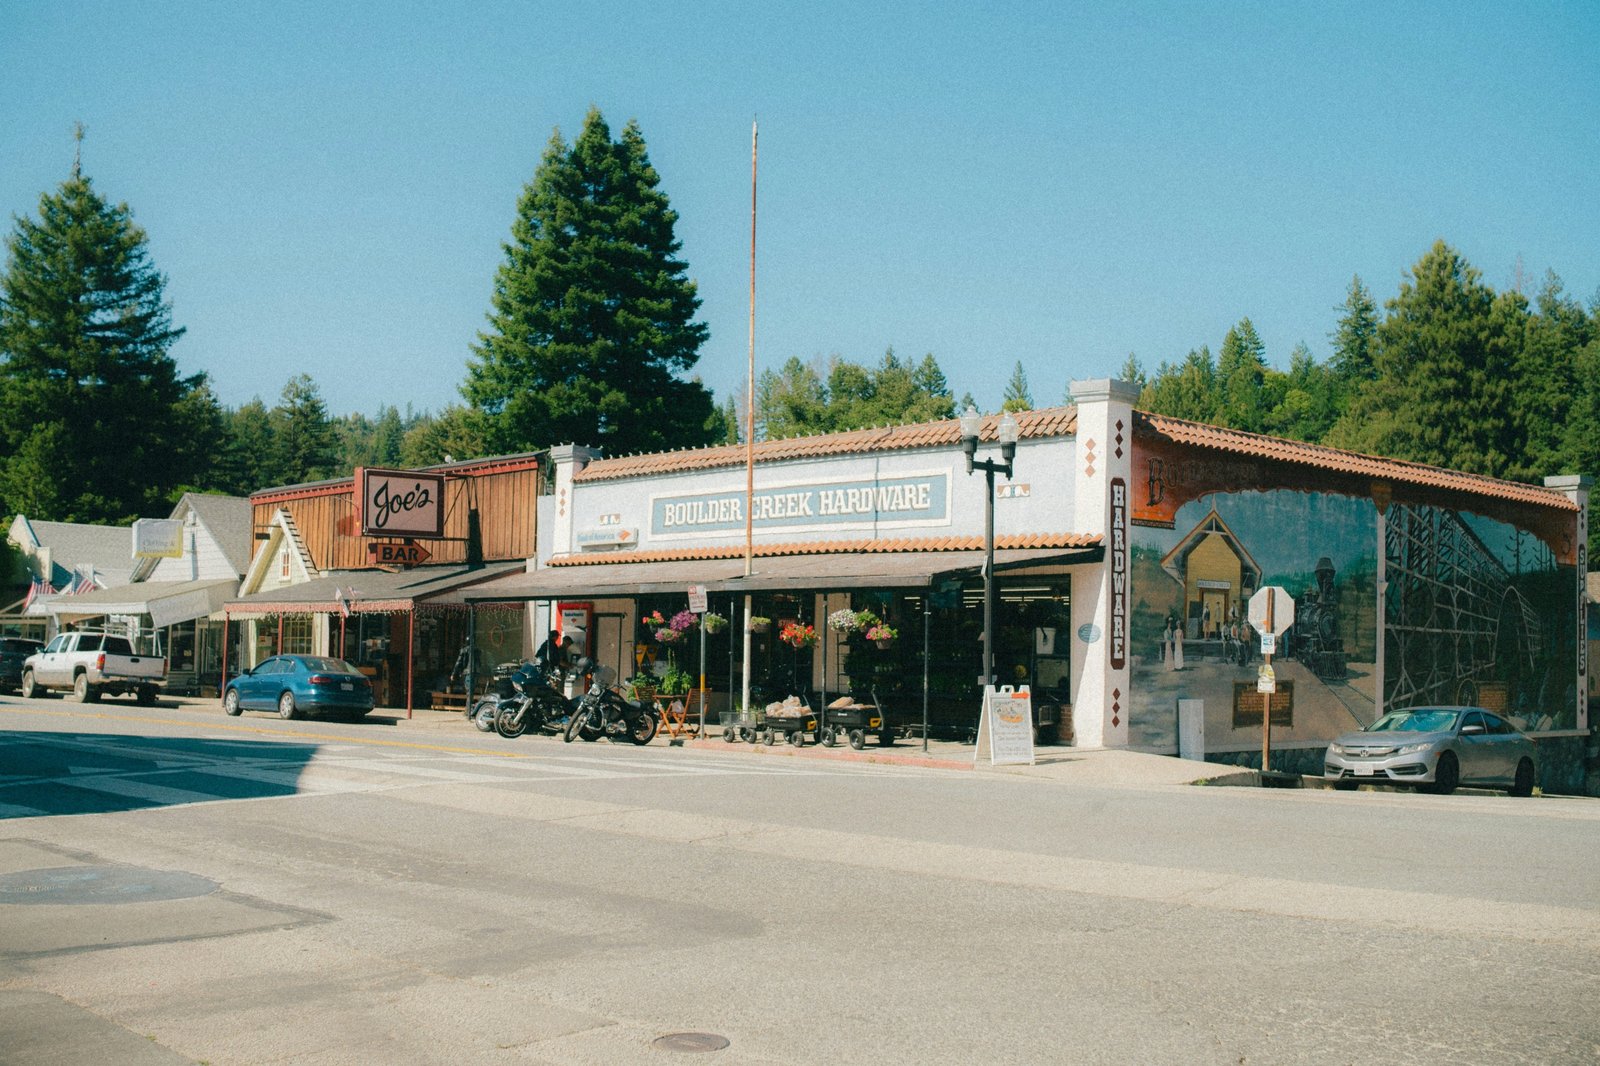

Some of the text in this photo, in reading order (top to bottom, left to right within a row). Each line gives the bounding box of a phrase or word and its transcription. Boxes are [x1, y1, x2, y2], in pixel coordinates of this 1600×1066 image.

[373, 480, 434, 528] Joe's
[664, 483, 931, 527] BOULDER CREEK HARDWARE
[383, 547, 419, 561] BAR
[1113, 485, 1125, 659] HARDWARE
